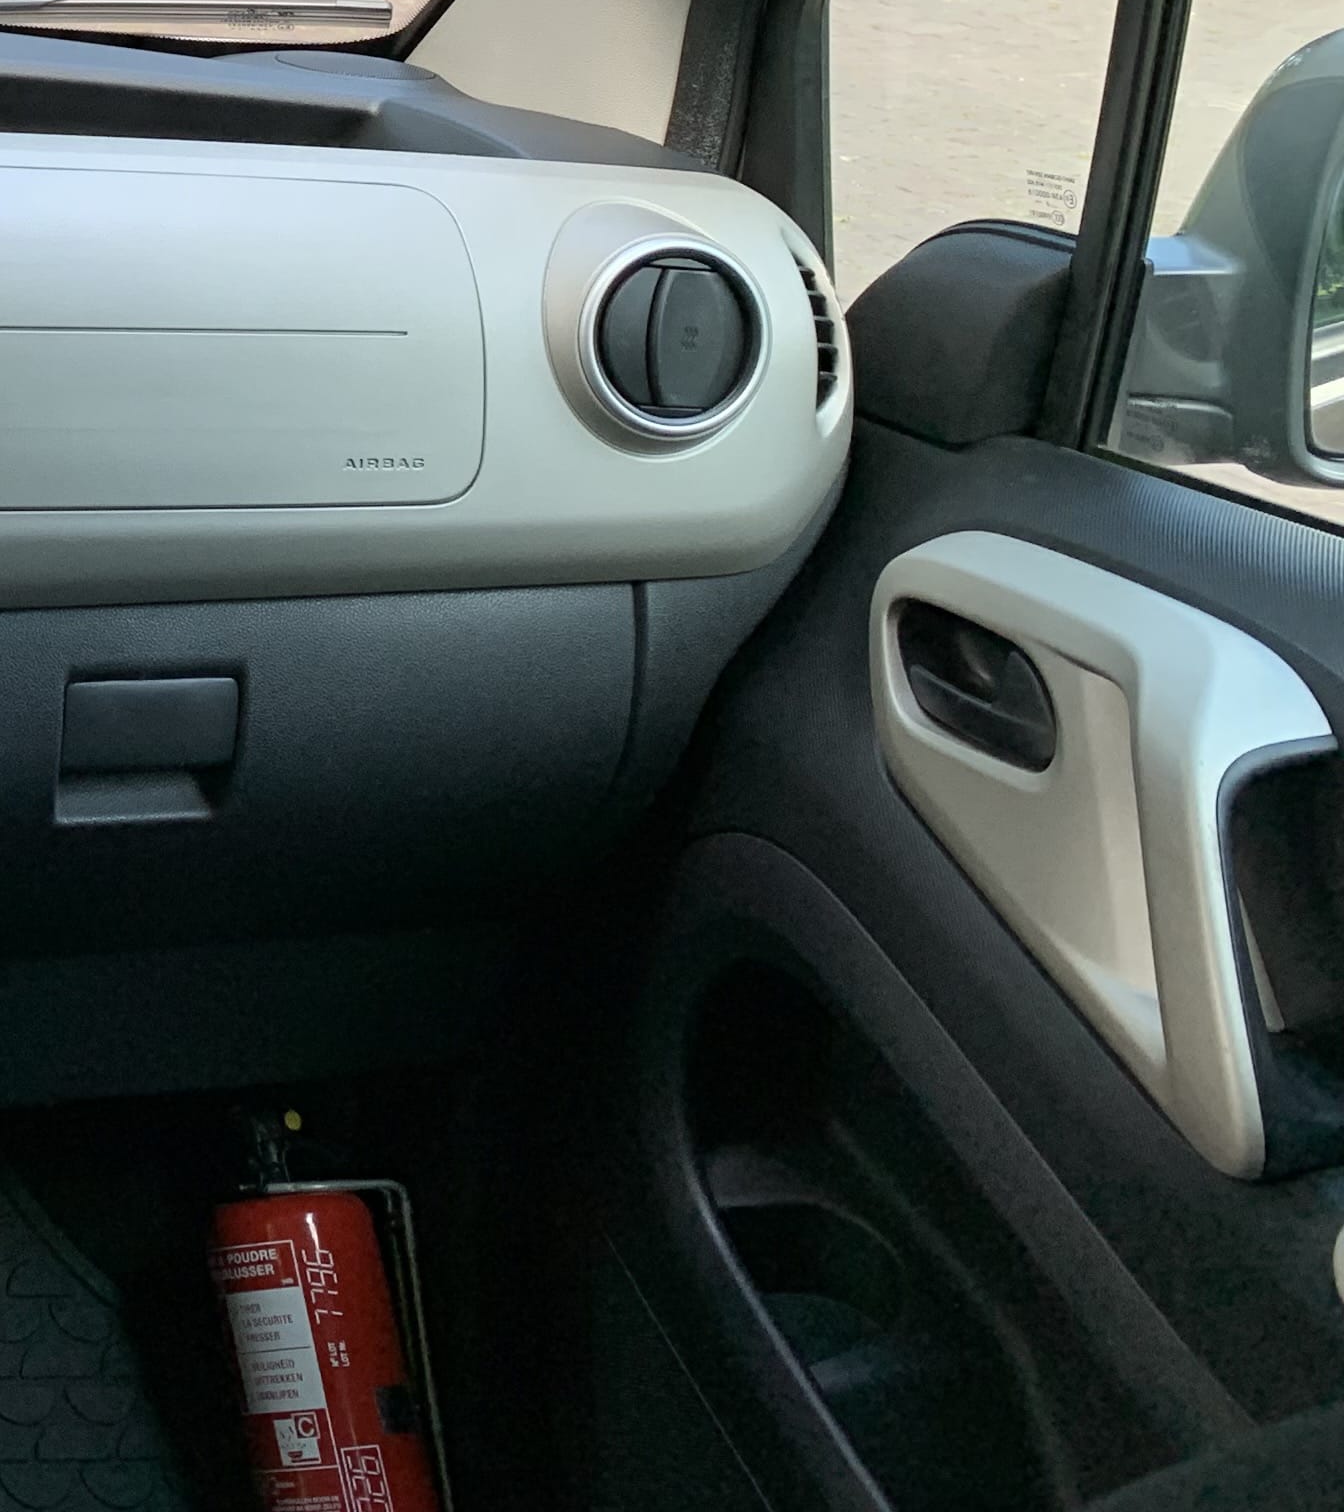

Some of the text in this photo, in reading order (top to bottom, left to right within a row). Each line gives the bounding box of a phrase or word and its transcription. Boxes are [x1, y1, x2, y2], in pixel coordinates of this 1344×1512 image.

[343, 457, 425, 471] AIRBAG
[227, 1248, 278, 1265] POUDRE
[253, 1314, 294, 1328] SECURITE
[327, 1341, 338, 1357] LOT
[297, 1416, 316, 1437] C
